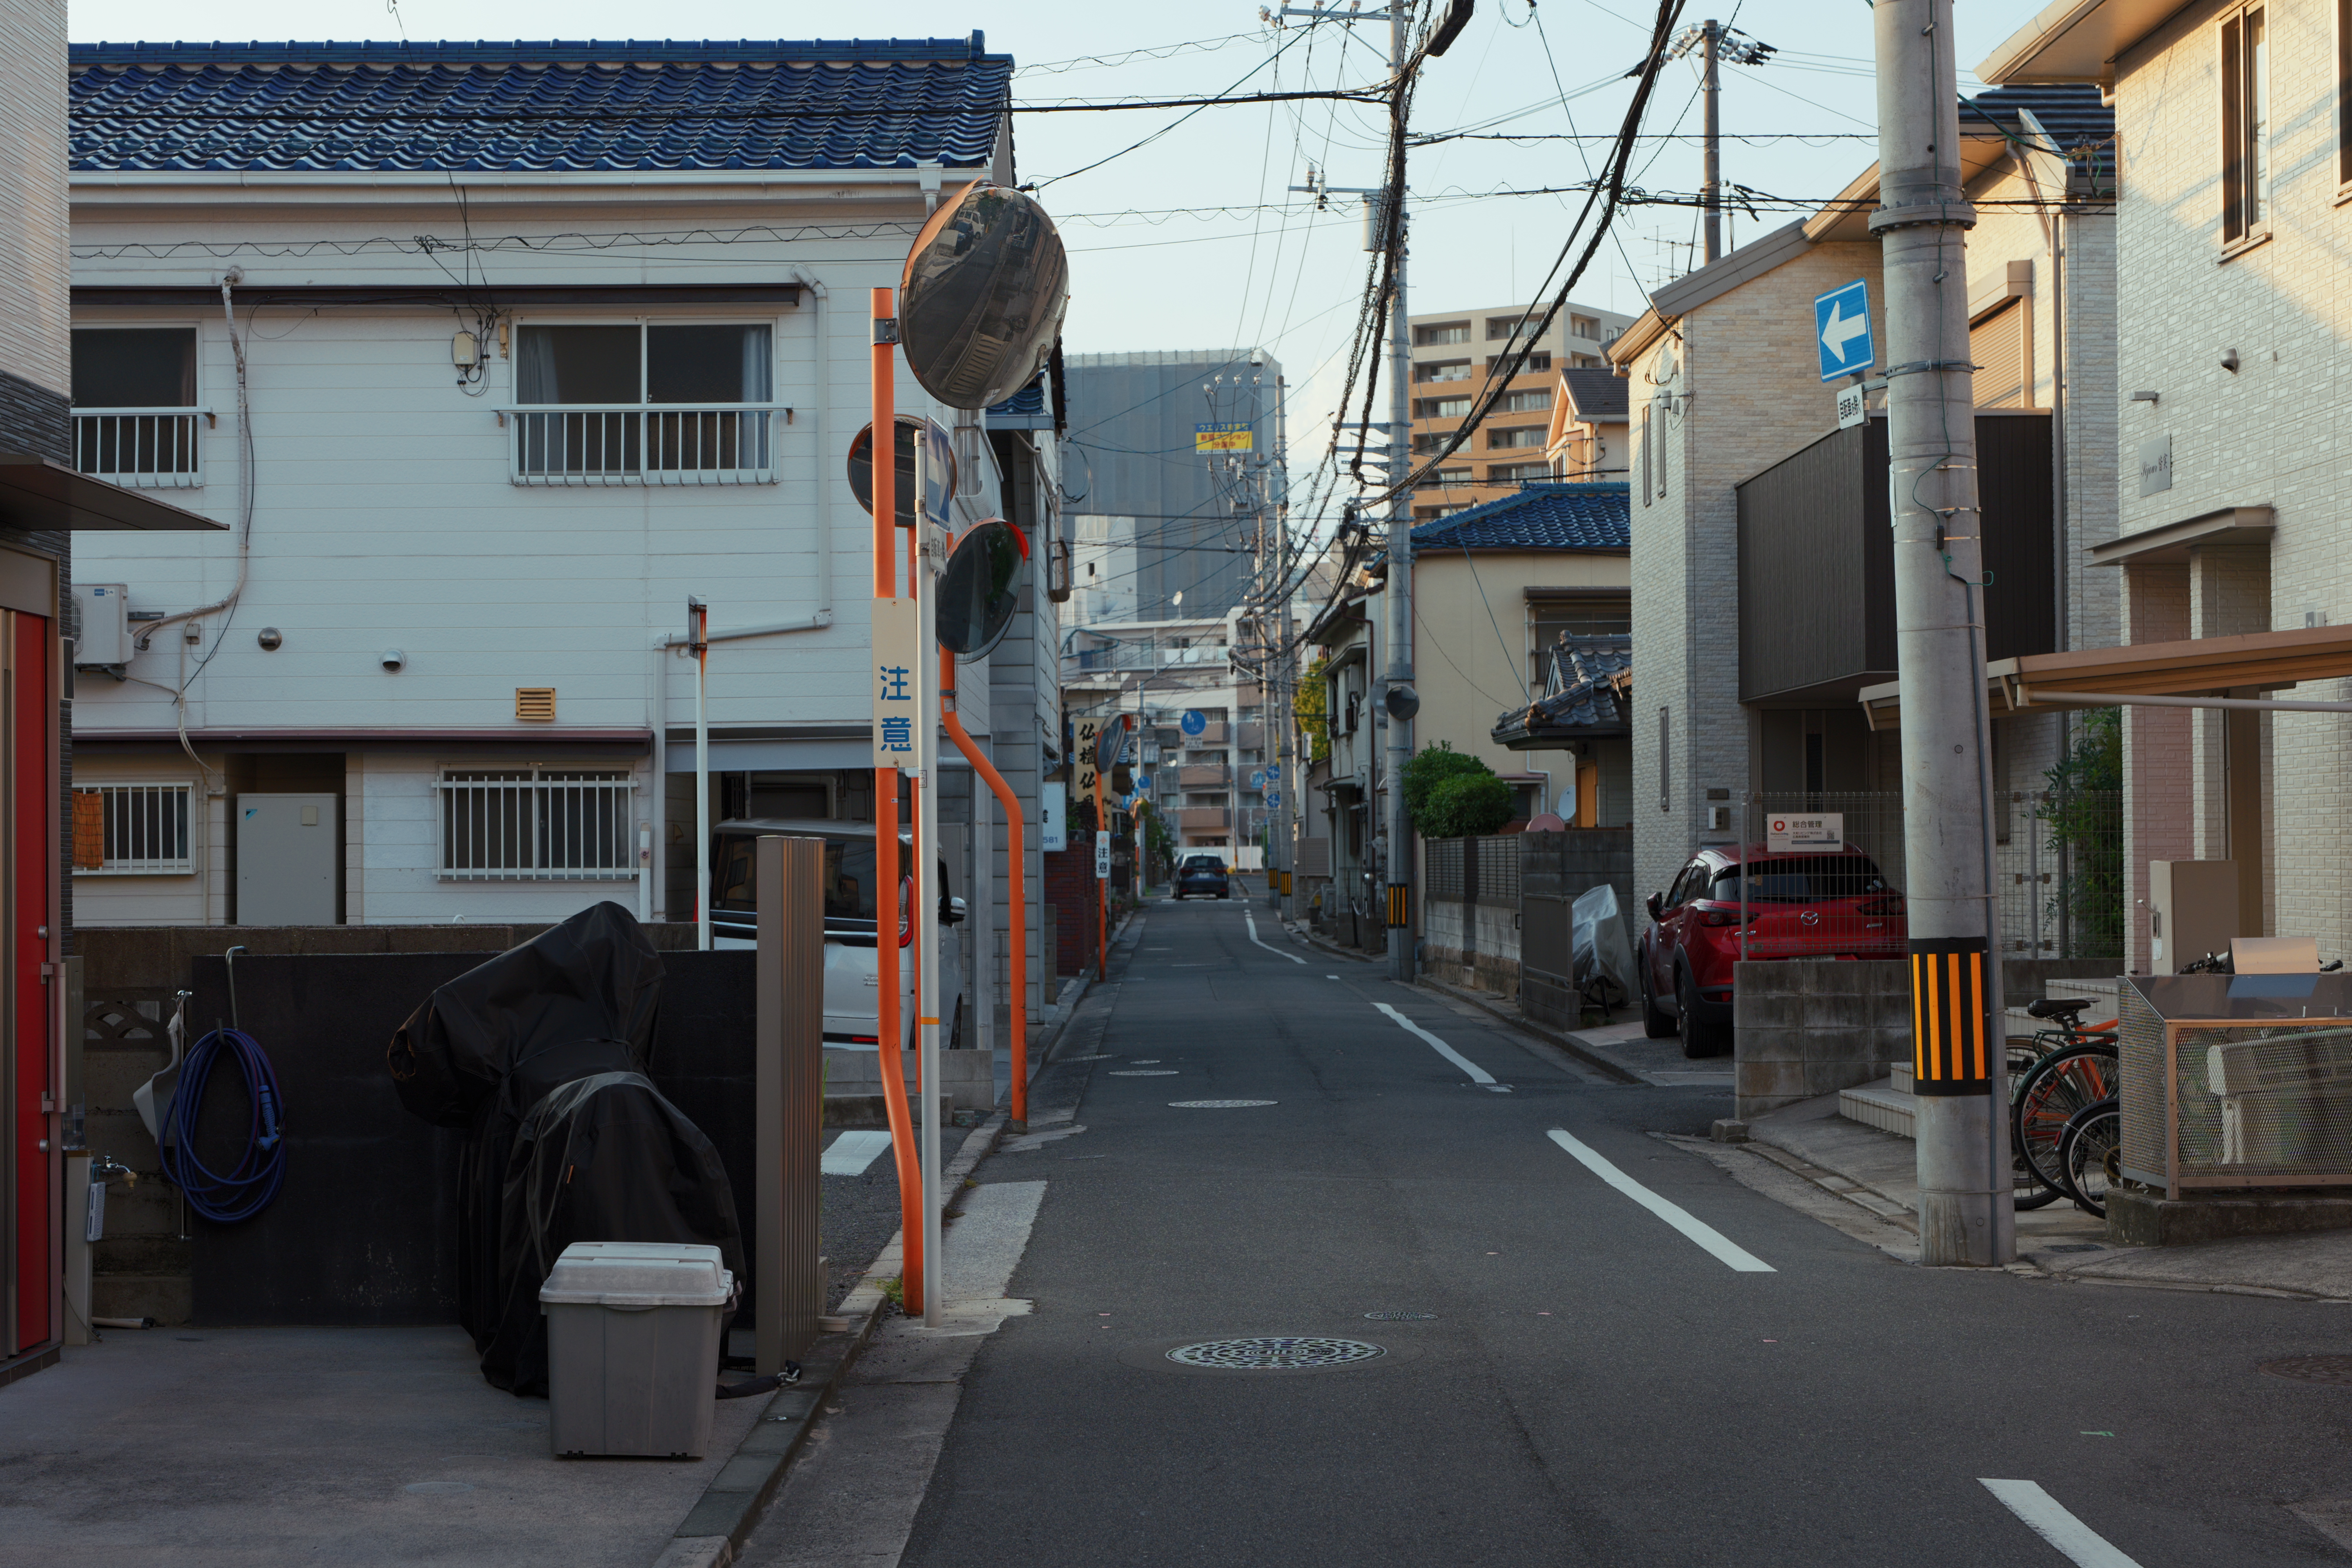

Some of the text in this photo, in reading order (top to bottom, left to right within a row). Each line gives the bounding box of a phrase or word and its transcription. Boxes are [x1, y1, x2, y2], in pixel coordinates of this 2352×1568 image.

[1840, 394, 1862, 420] 自転車を除く
[880, 666, 912, 752] 注意
[1098, 847, 1108, 873] 注意
